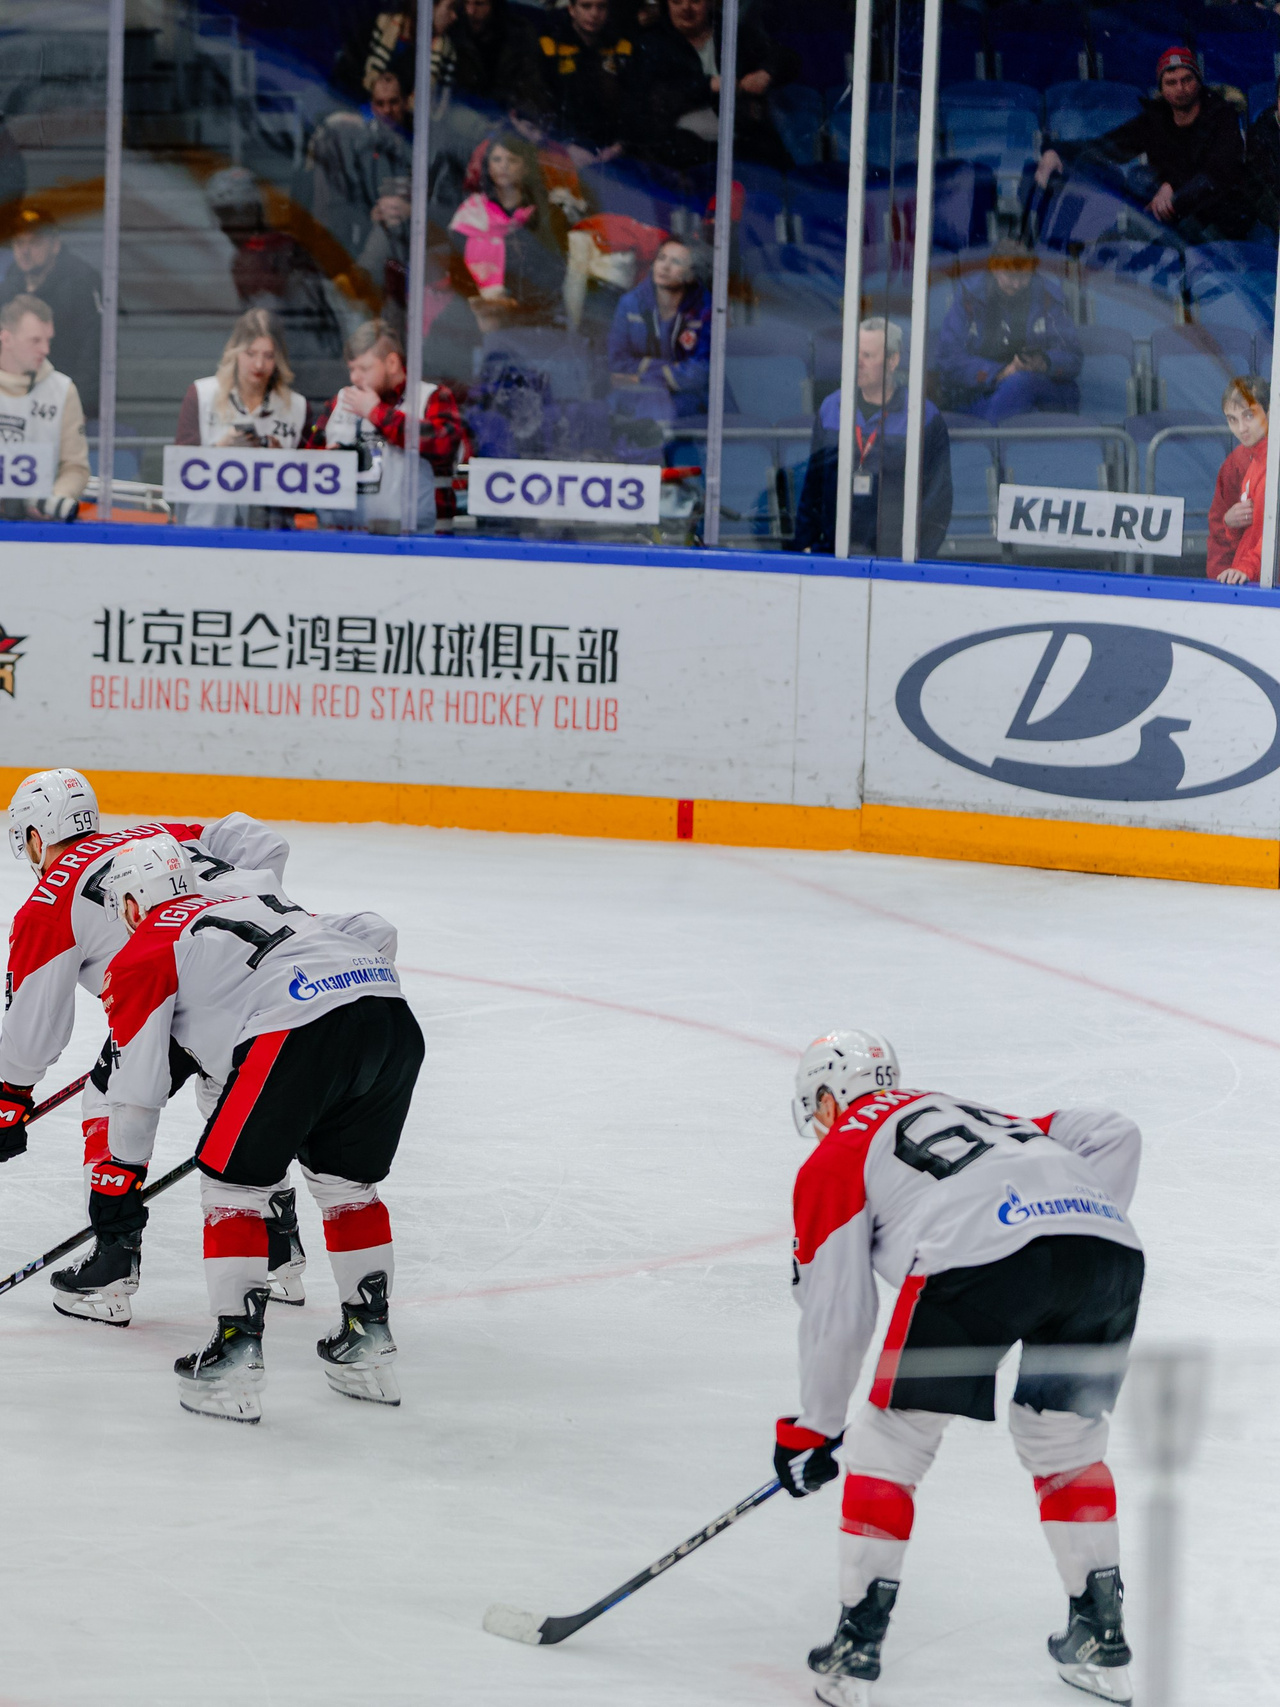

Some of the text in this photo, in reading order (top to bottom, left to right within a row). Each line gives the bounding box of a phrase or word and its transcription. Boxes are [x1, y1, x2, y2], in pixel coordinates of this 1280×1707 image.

[30, 400, 57, 421] 249
[180, 458, 341, 495] согаз
[485, 470, 645, 511] согаз
[1009, 495, 1172, 542] KHL.RU
[92, 607, 619, 685] 北京昆仑鸿星冰球俱乐部
[90, 674, 619, 733] BEIJING KUNLUN RED STAR HOCKEY CLUB
[73, 811, 93, 832] 59
[168, 874, 188, 897] 14
[875, 1065, 893, 1087] 65
[91, 1171, 125, 1187] CM
